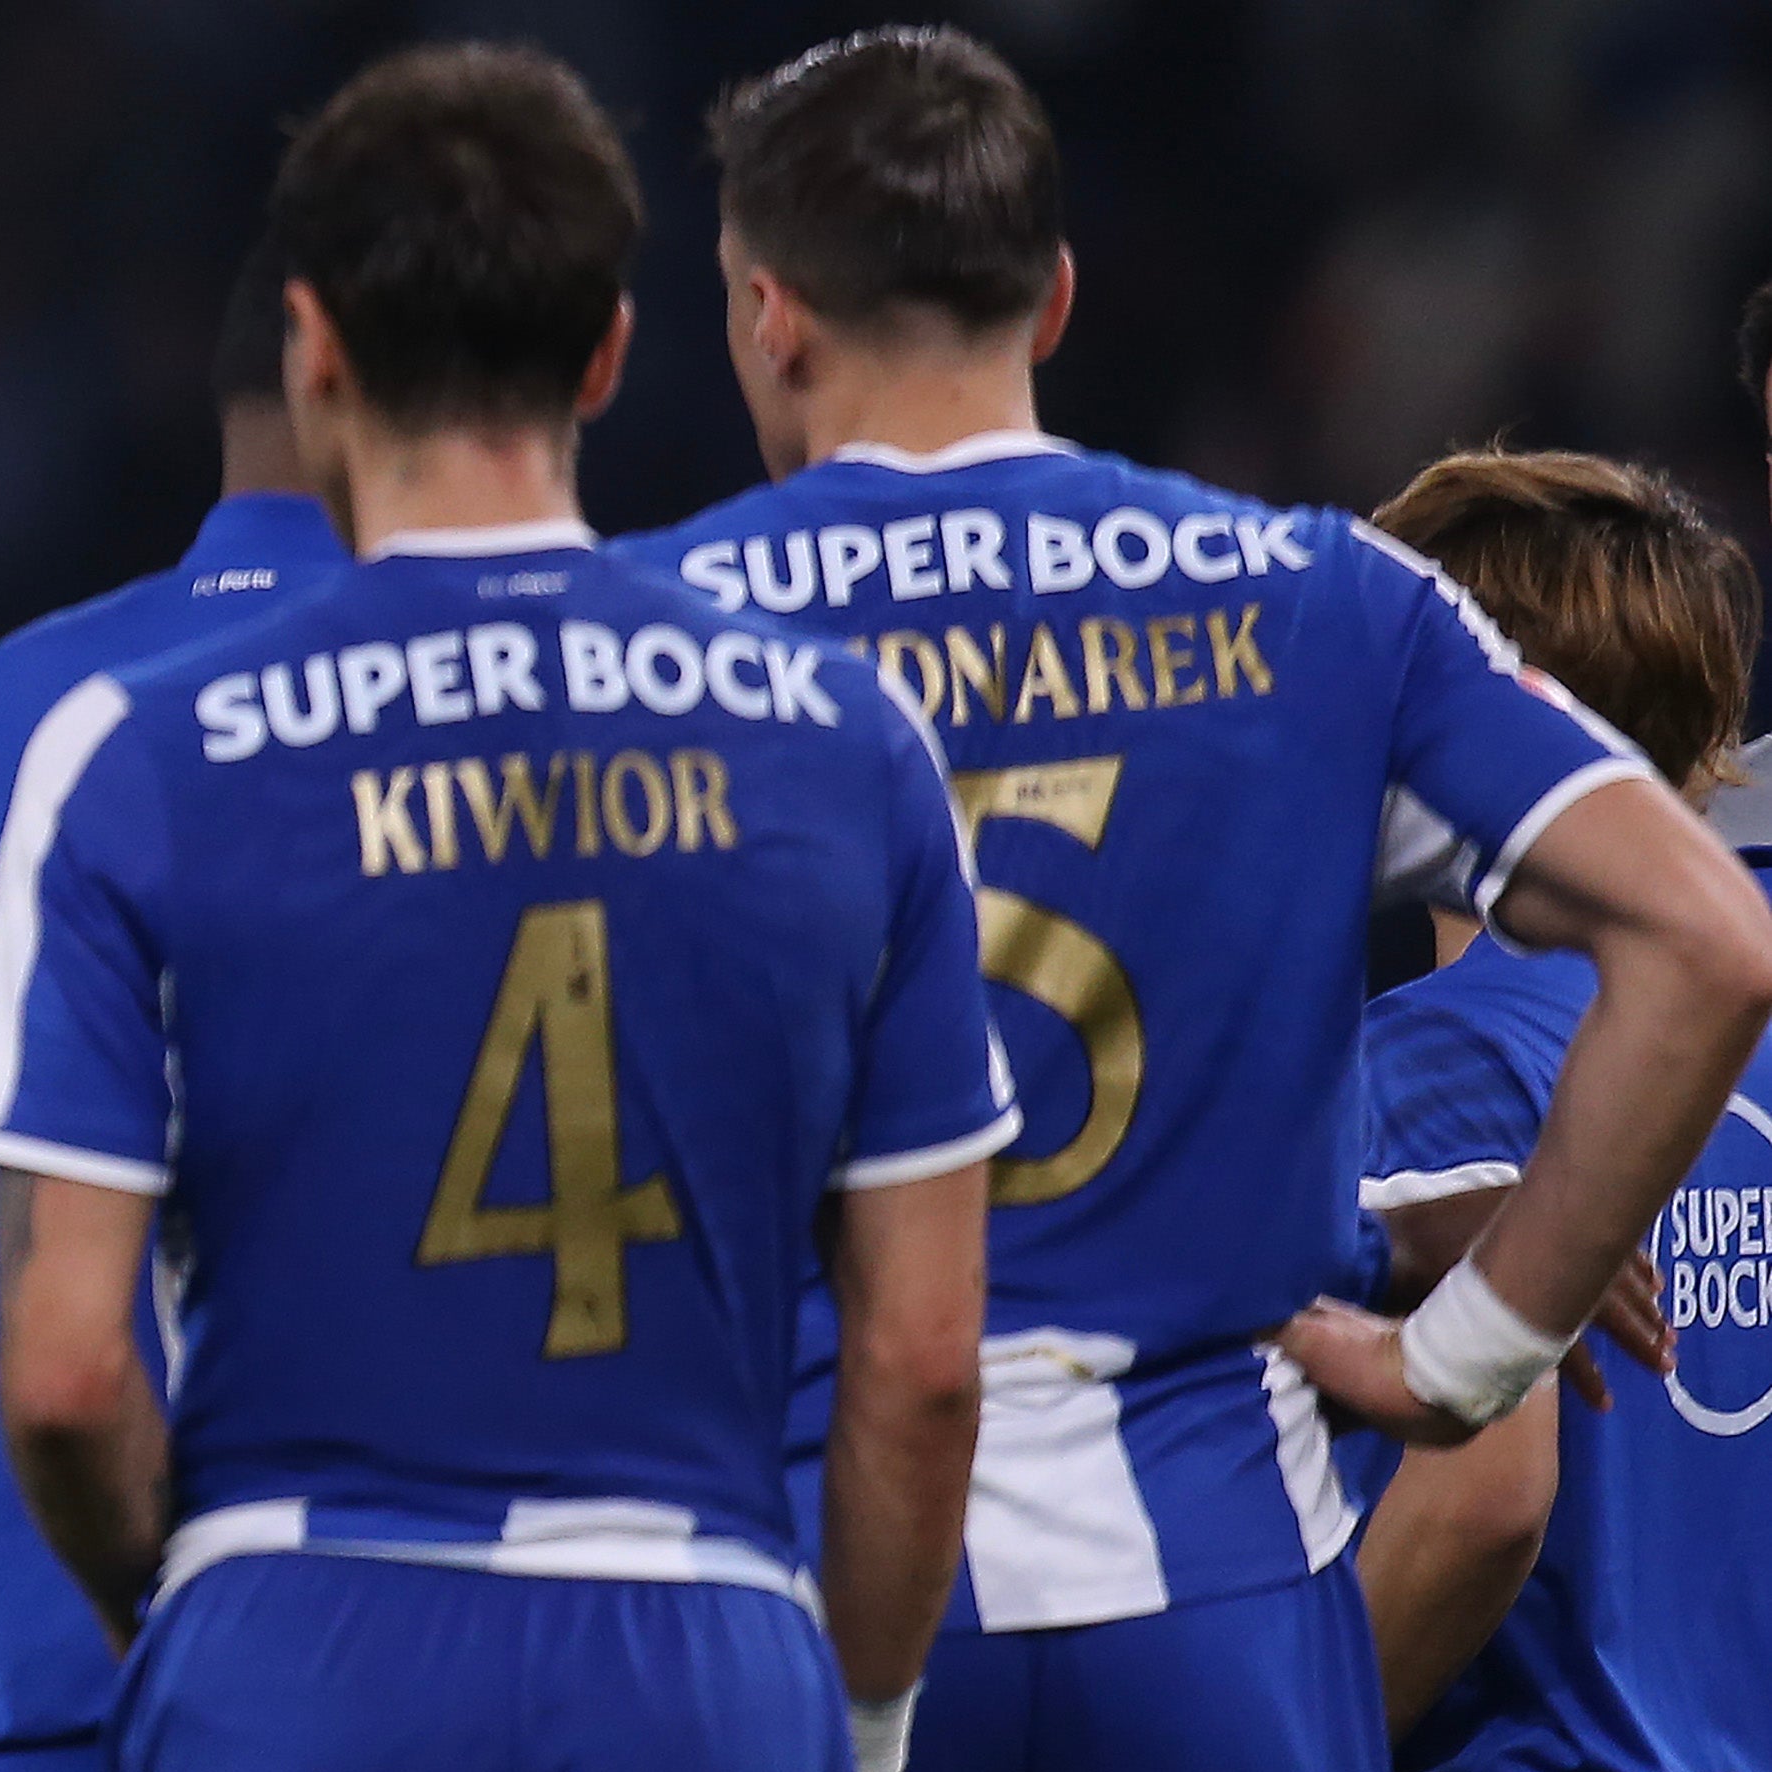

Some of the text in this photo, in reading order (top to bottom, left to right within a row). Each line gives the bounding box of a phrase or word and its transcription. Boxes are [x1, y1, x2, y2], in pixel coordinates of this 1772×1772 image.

[680, 505, 1313, 614] SUPER BOCK
[194, 620, 841, 764] SUPER BOCK
[845, 602, 1274, 729] DNAREK
[350, 748, 741, 878] KIWIOR
[413, 897, 683, 1363] 4
